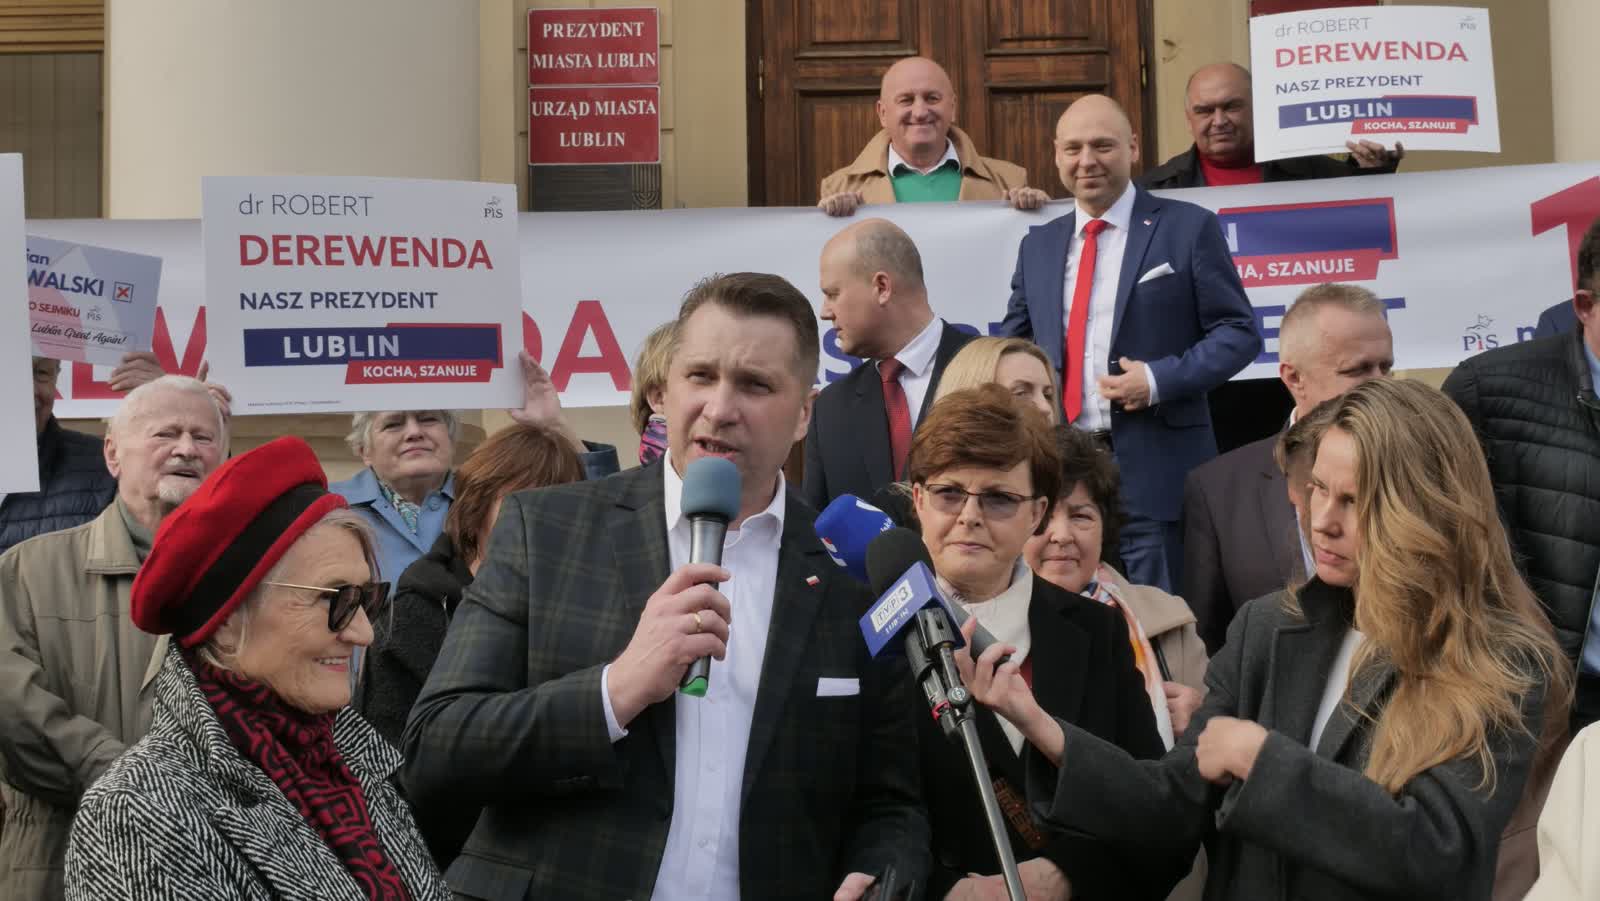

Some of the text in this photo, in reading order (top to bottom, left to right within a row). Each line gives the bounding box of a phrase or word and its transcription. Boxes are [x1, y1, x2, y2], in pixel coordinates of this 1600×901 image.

[543, 22, 644, 38] PREZYDENT
[1275, 17, 1372, 38] dr ROBERT
[532, 52, 657, 69] MIASTA LUBLIN
[1275, 41, 1468, 68] DEREWENDA
[1276, 75, 1424, 95] NASZ PREZYDENT
[531, 99, 657, 120] URZĄD MIASTA
[1306, 102, 1393, 122] LUBLIN
[1364, 120, 1456, 131] KOCHA, SZANUJE
[559, 132, 625, 147] LUBLIN
[239, 193, 374, 217] dr ROBERT
[239, 234, 494, 270] DEREWENDA
[1268, 258, 1355, 277] SZANUJE
[28, 268, 105, 297] WALSKI
[38, 303, 81, 317] SEJMIKU
[240, 291, 438, 310] NASZ PREZYDENT
[31, 322, 128, 346] Lublin Great Again!
[283, 335, 400, 359] LUBLIN
[362, 364, 478, 379] KOCHA, SZANUJE
